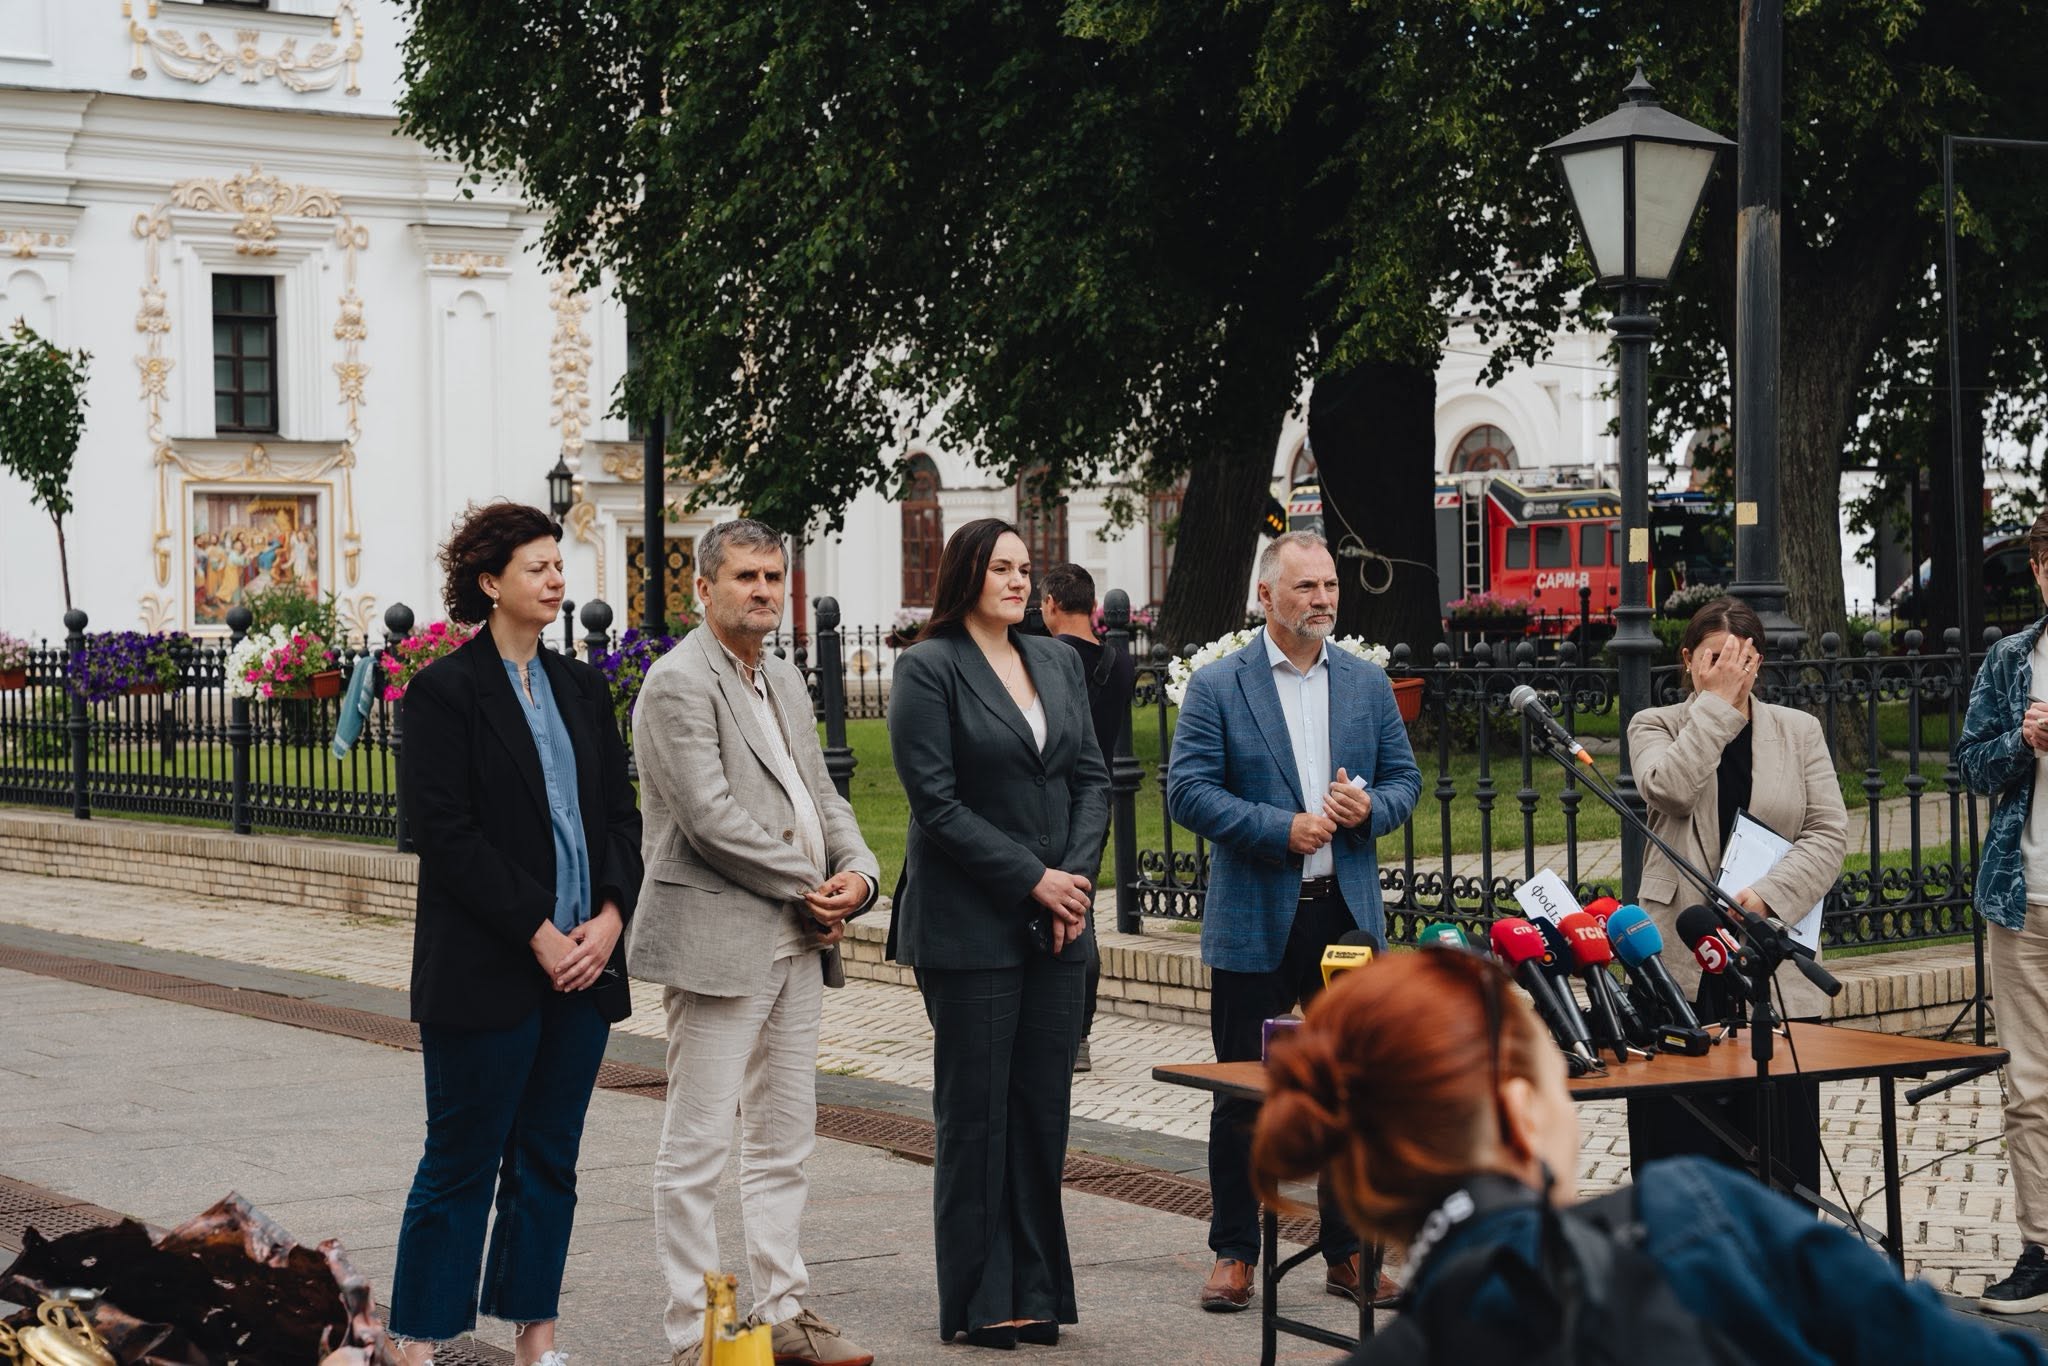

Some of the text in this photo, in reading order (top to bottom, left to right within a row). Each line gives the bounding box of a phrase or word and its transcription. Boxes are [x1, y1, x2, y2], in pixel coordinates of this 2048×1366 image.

[1531, 884, 1561, 926] строф
[1575, 927, 1606, 941] ТСН
[1698, 940, 1721, 970] 5
